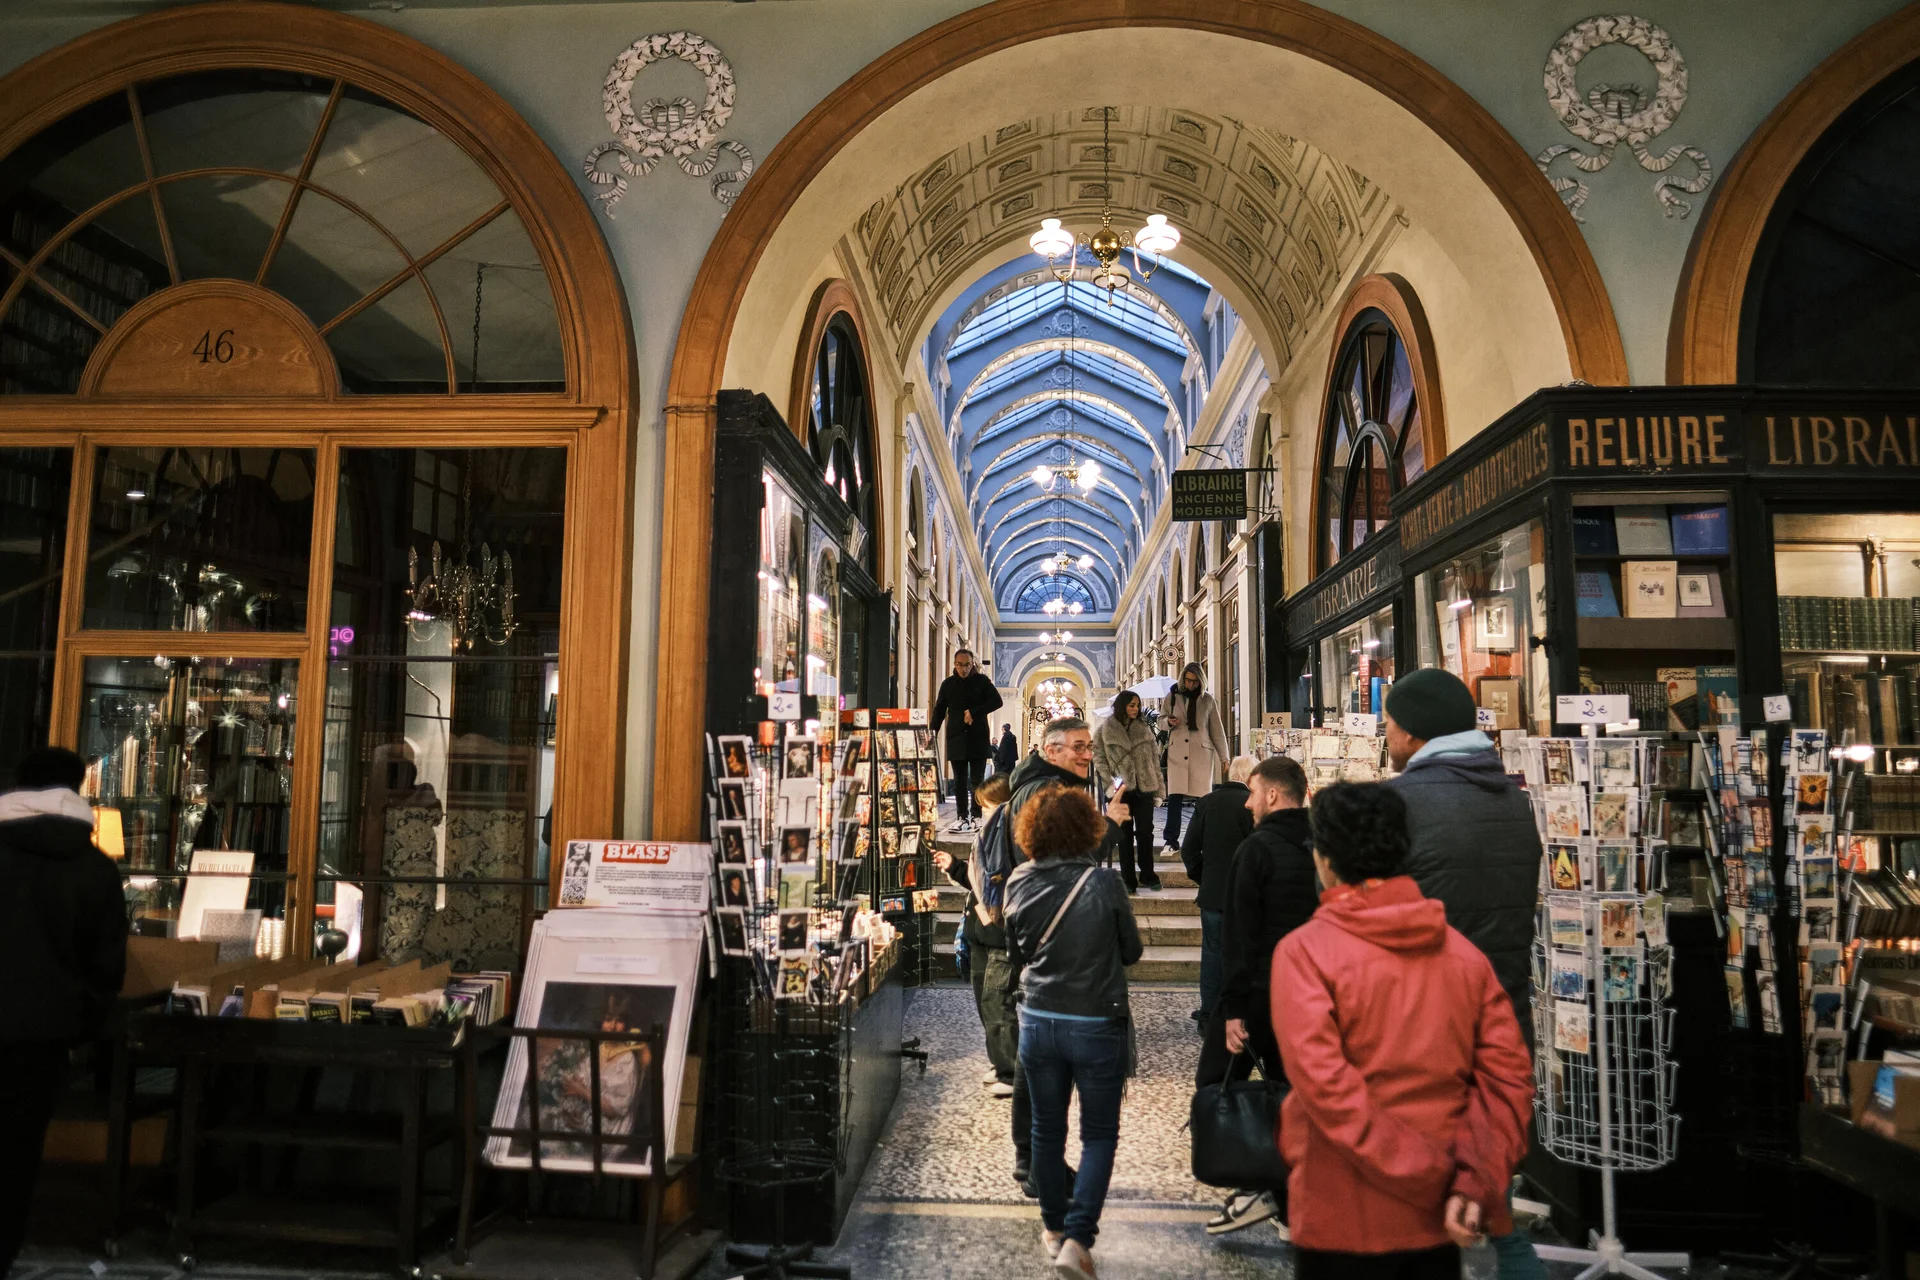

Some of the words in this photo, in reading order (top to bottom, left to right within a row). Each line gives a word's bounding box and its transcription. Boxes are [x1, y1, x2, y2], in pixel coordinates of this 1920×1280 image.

[192, 329, 234, 363] 46
[1568, 415, 1729, 467] RELIURE
[1174, 474, 1243, 492] LIBRAIRIE
[1175, 493, 1244, 504] ANCIENNE
[1175, 505, 1244, 517] MODERNE
[1425, 484, 1454, 537] VENTE
[1314, 555, 1378, 625] LIBRAIRIE
[602, 843, 670, 864] BLASE
